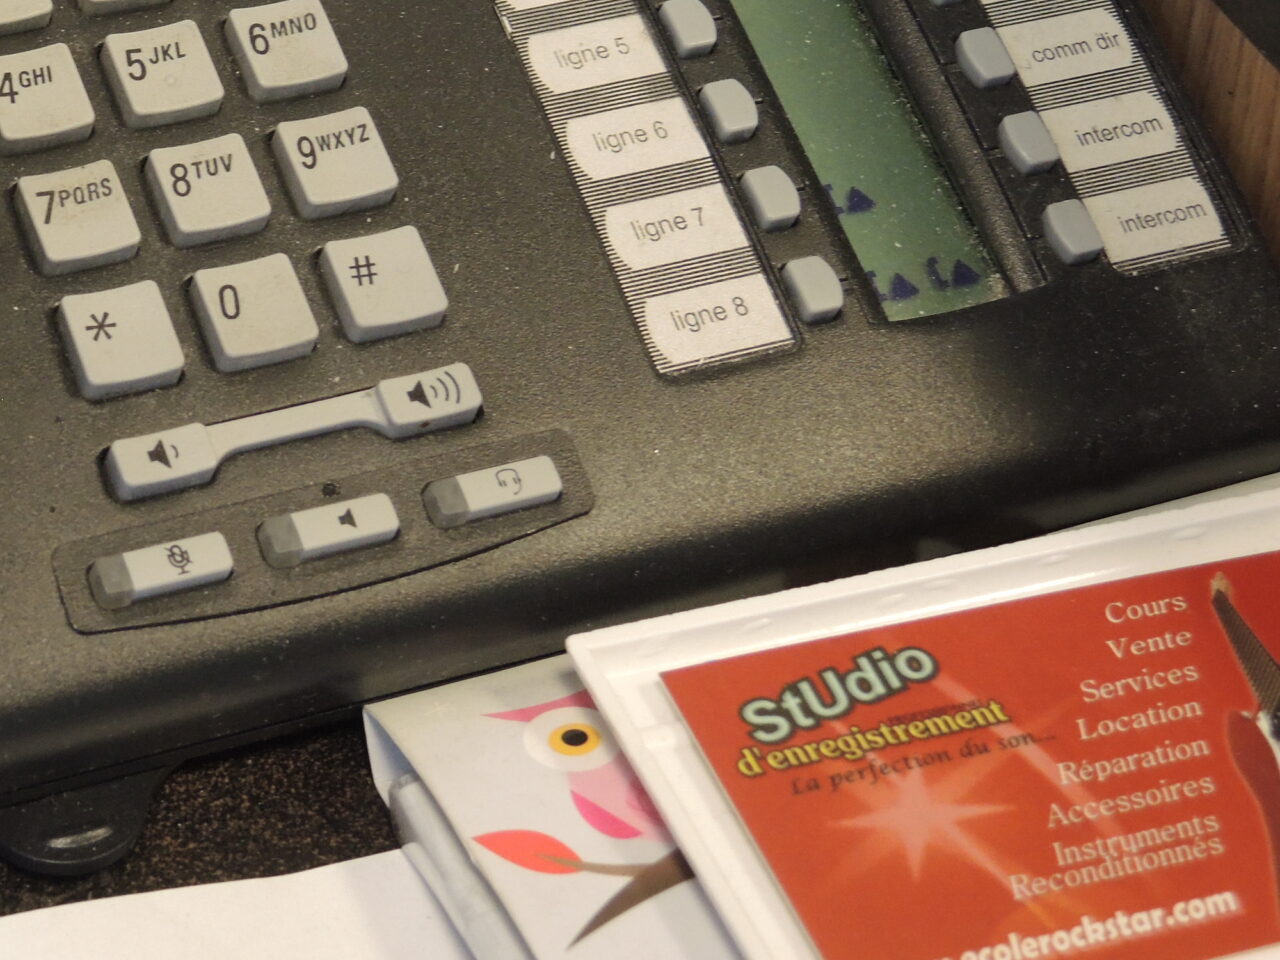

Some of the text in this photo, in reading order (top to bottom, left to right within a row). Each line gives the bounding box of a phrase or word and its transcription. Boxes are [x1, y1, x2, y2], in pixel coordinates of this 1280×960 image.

[553, 37, 630, 70] ligne 5
[1031, 31, 1120, 65] comm dir
[591, 120, 669, 154] ligne 6
[1075, 114, 1163, 147] intercom
[629, 207, 705, 242] ligne 7
[1118, 201, 1207, 234] intercom
[219, 283, 240, 320] 0
[669, 296, 749, 333] ligne 8
[1104, 595, 1187, 623] Cours
[1105, 630, 1192, 659] Vente
[1079, 665, 1199, 703] Services
[737, 700, 1010, 777] d'enregistrement
[1076, 700, 1203, 740] Location
[829, 750, 952, 791] perfection
[959, 739, 991, 758] du
[1056, 739, 1211, 786] Réparation
[1047, 776, 1216, 828] Accessoires
[1052, 814, 1221, 866] Instruments
[1009, 836, 1225, 901] Reconditionnés
